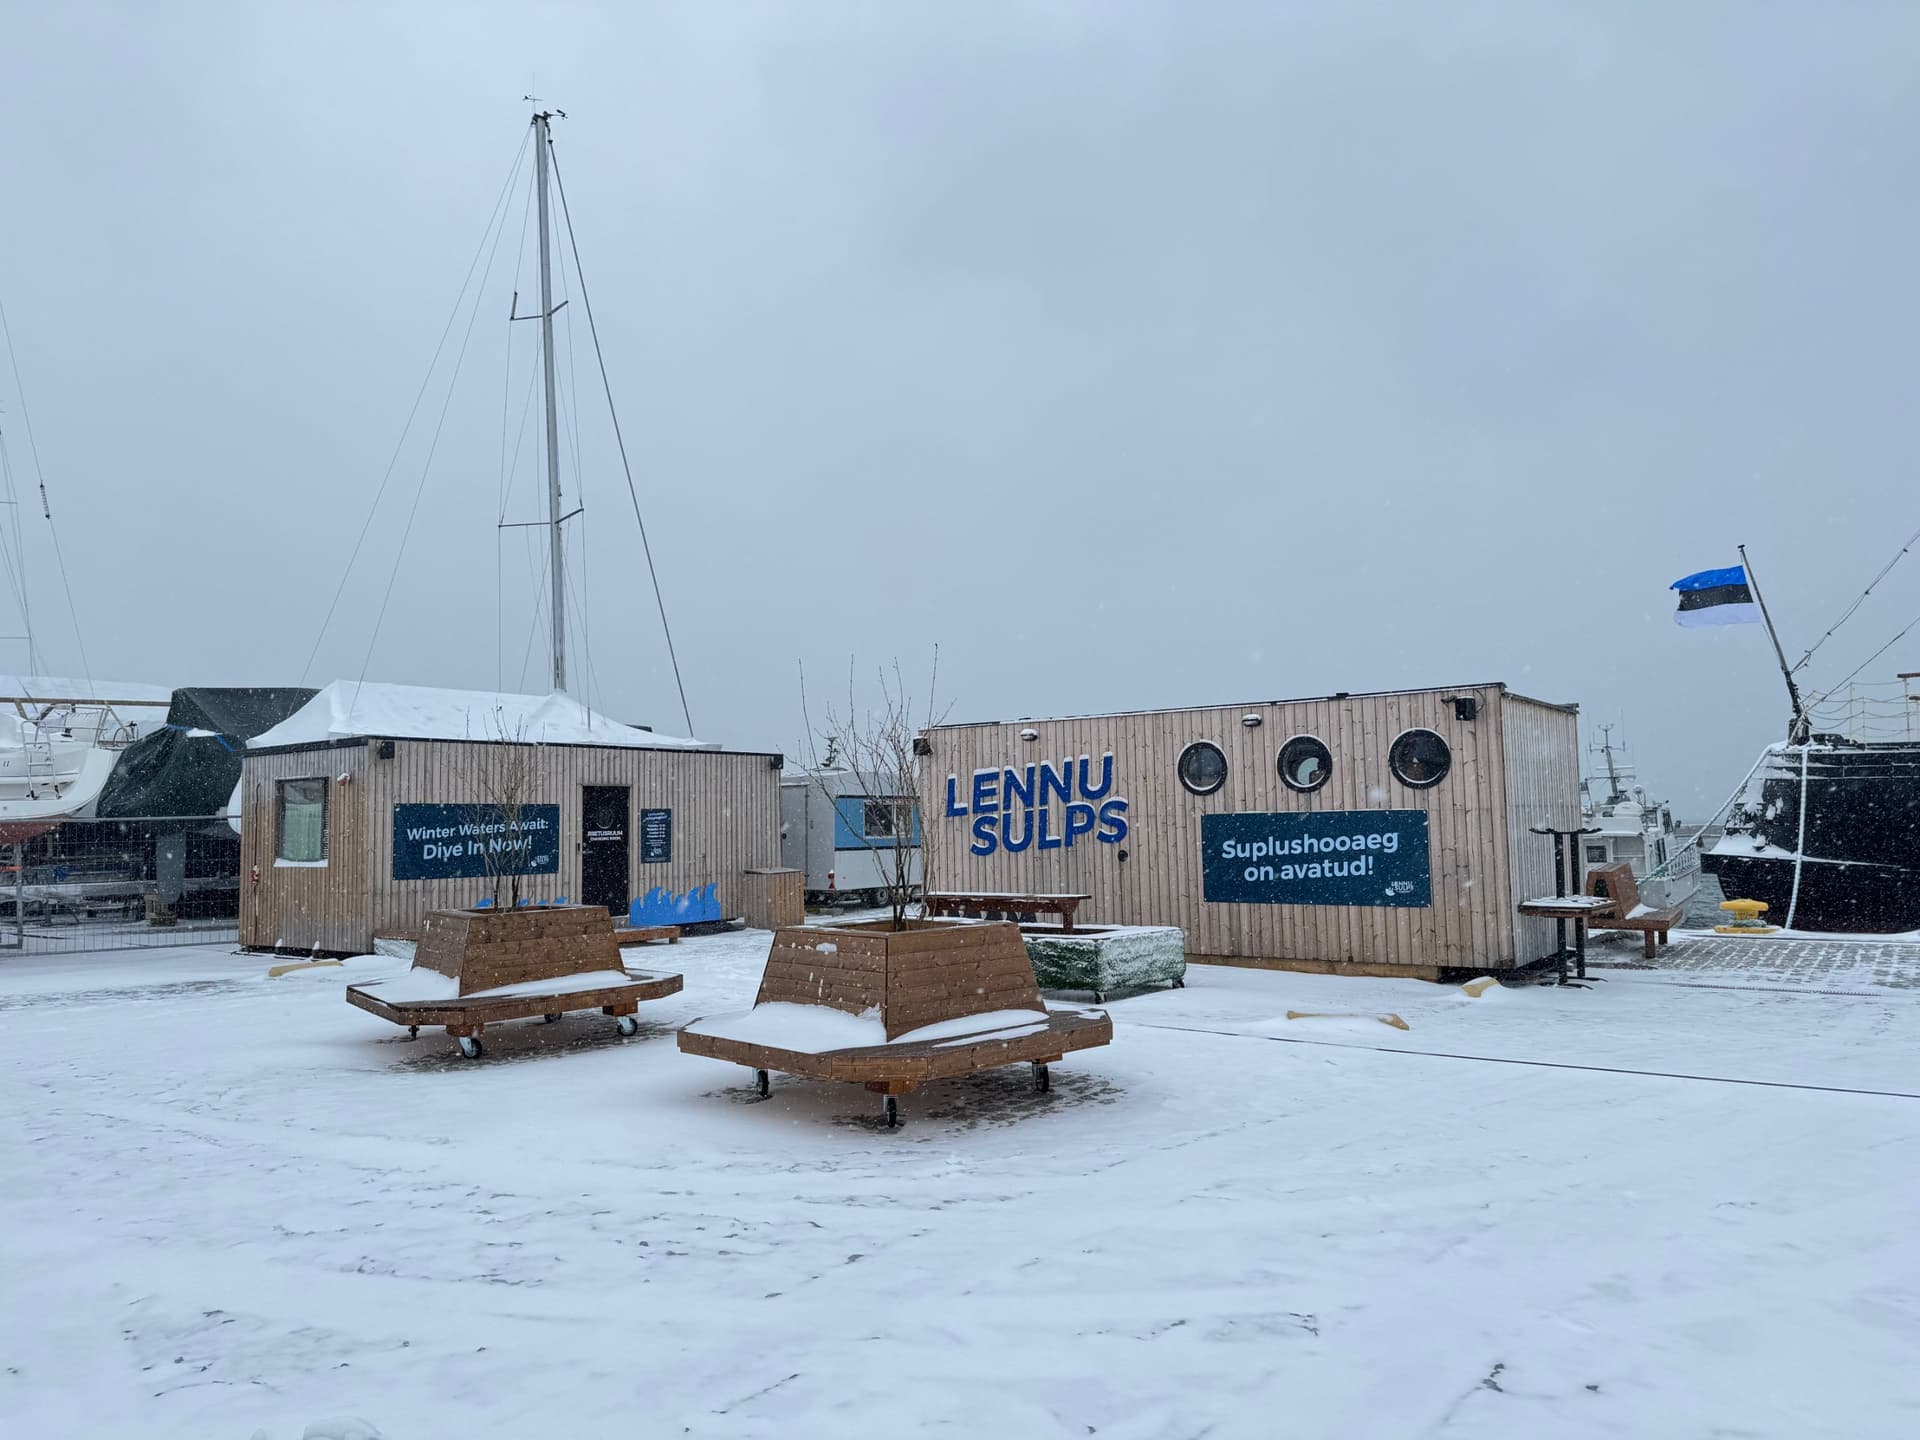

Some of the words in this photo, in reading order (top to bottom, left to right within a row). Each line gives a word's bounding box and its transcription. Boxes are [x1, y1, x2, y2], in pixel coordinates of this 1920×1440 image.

[946, 753, 1113, 817] LENNU
[407, 826, 456, 841] Winter
[459, 822, 505, 836] Waters
[970, 796, 1129, 856] SULPS
[423, 842, 463, 860] Dive
[468, 841, 484, 856] In
[489, 836, 532, 853] Now!
[1221, 832, 1399, 862] Suplushooaeg
[1243, 863, 1274, 882] on
[1280, 855, 1374, 880] avatud!
